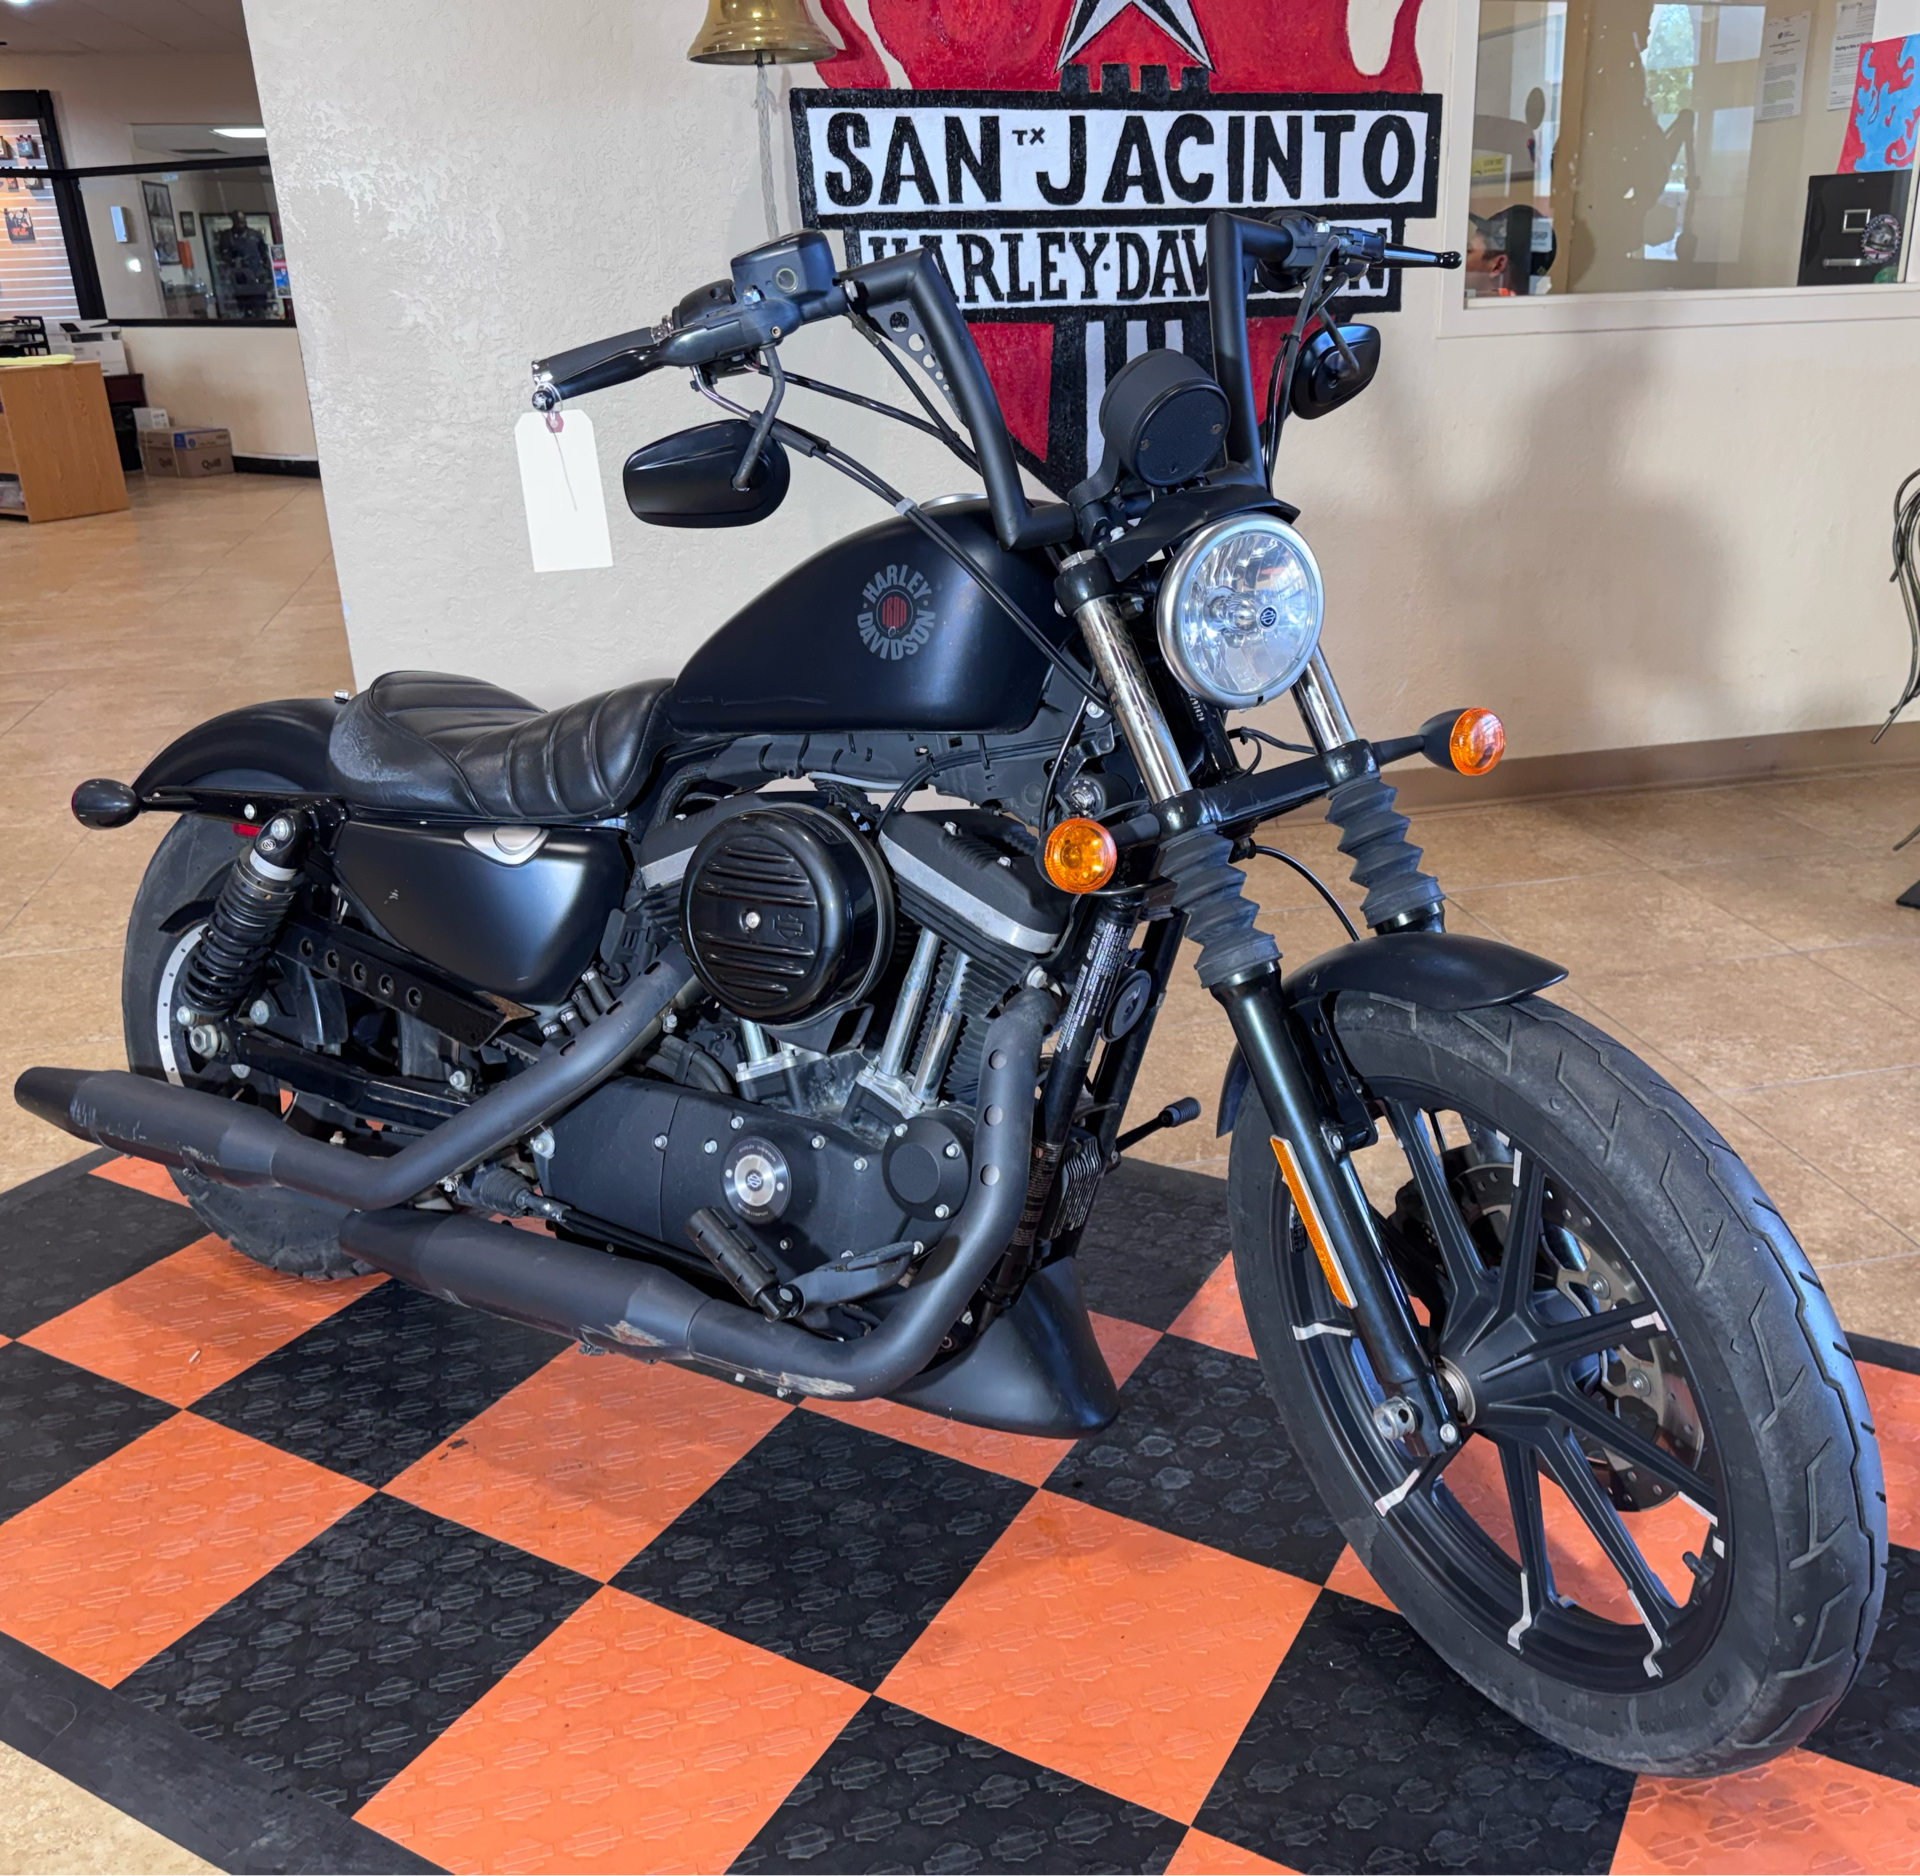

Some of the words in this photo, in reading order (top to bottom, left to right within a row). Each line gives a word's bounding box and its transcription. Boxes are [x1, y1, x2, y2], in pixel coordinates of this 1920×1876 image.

[825, 112, 1002, 206] SAN
[1012, 127, 1045, 145] TX
[1036, 113, 1416, 205] JACINTO
[862, 564, 932, 604] HARLEY
[857, 609, 936, 660] DAVIDSON
